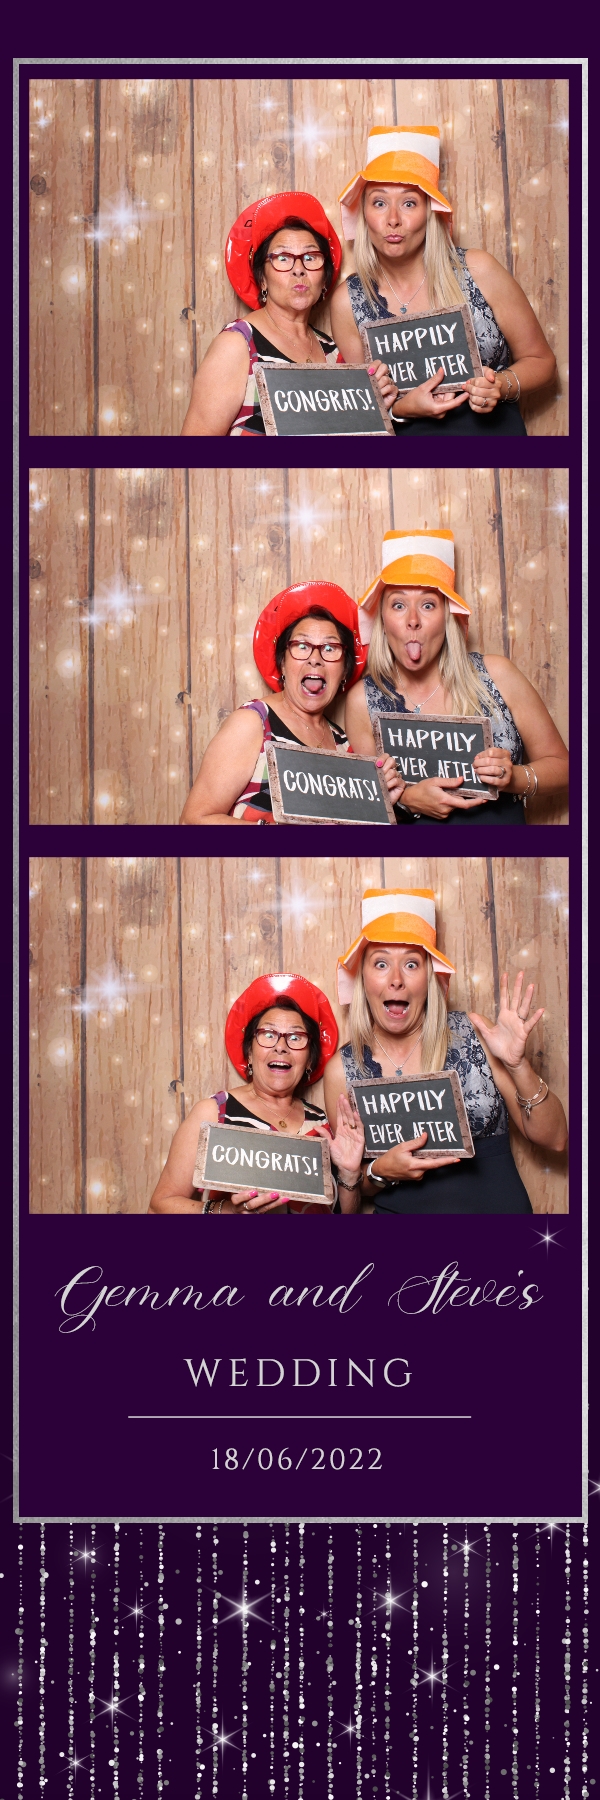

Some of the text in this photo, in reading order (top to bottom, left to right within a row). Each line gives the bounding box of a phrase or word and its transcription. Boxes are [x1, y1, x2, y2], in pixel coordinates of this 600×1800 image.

[374, 321, 458, 355] HAPPILY
[388, 353, 469, 383] VER AFTER
[273, 389, 376, 413] CONGRATS!
[387, 727, 477, 752] HAPPILY
[283, 769, 381, 802] CONGRATS!
[362, 1088, 446, 1115] HAPPILY
[369, 1121, 458, 1144] EVER AFTER
[212, 1144, 319, 1177] CONGRATS!
